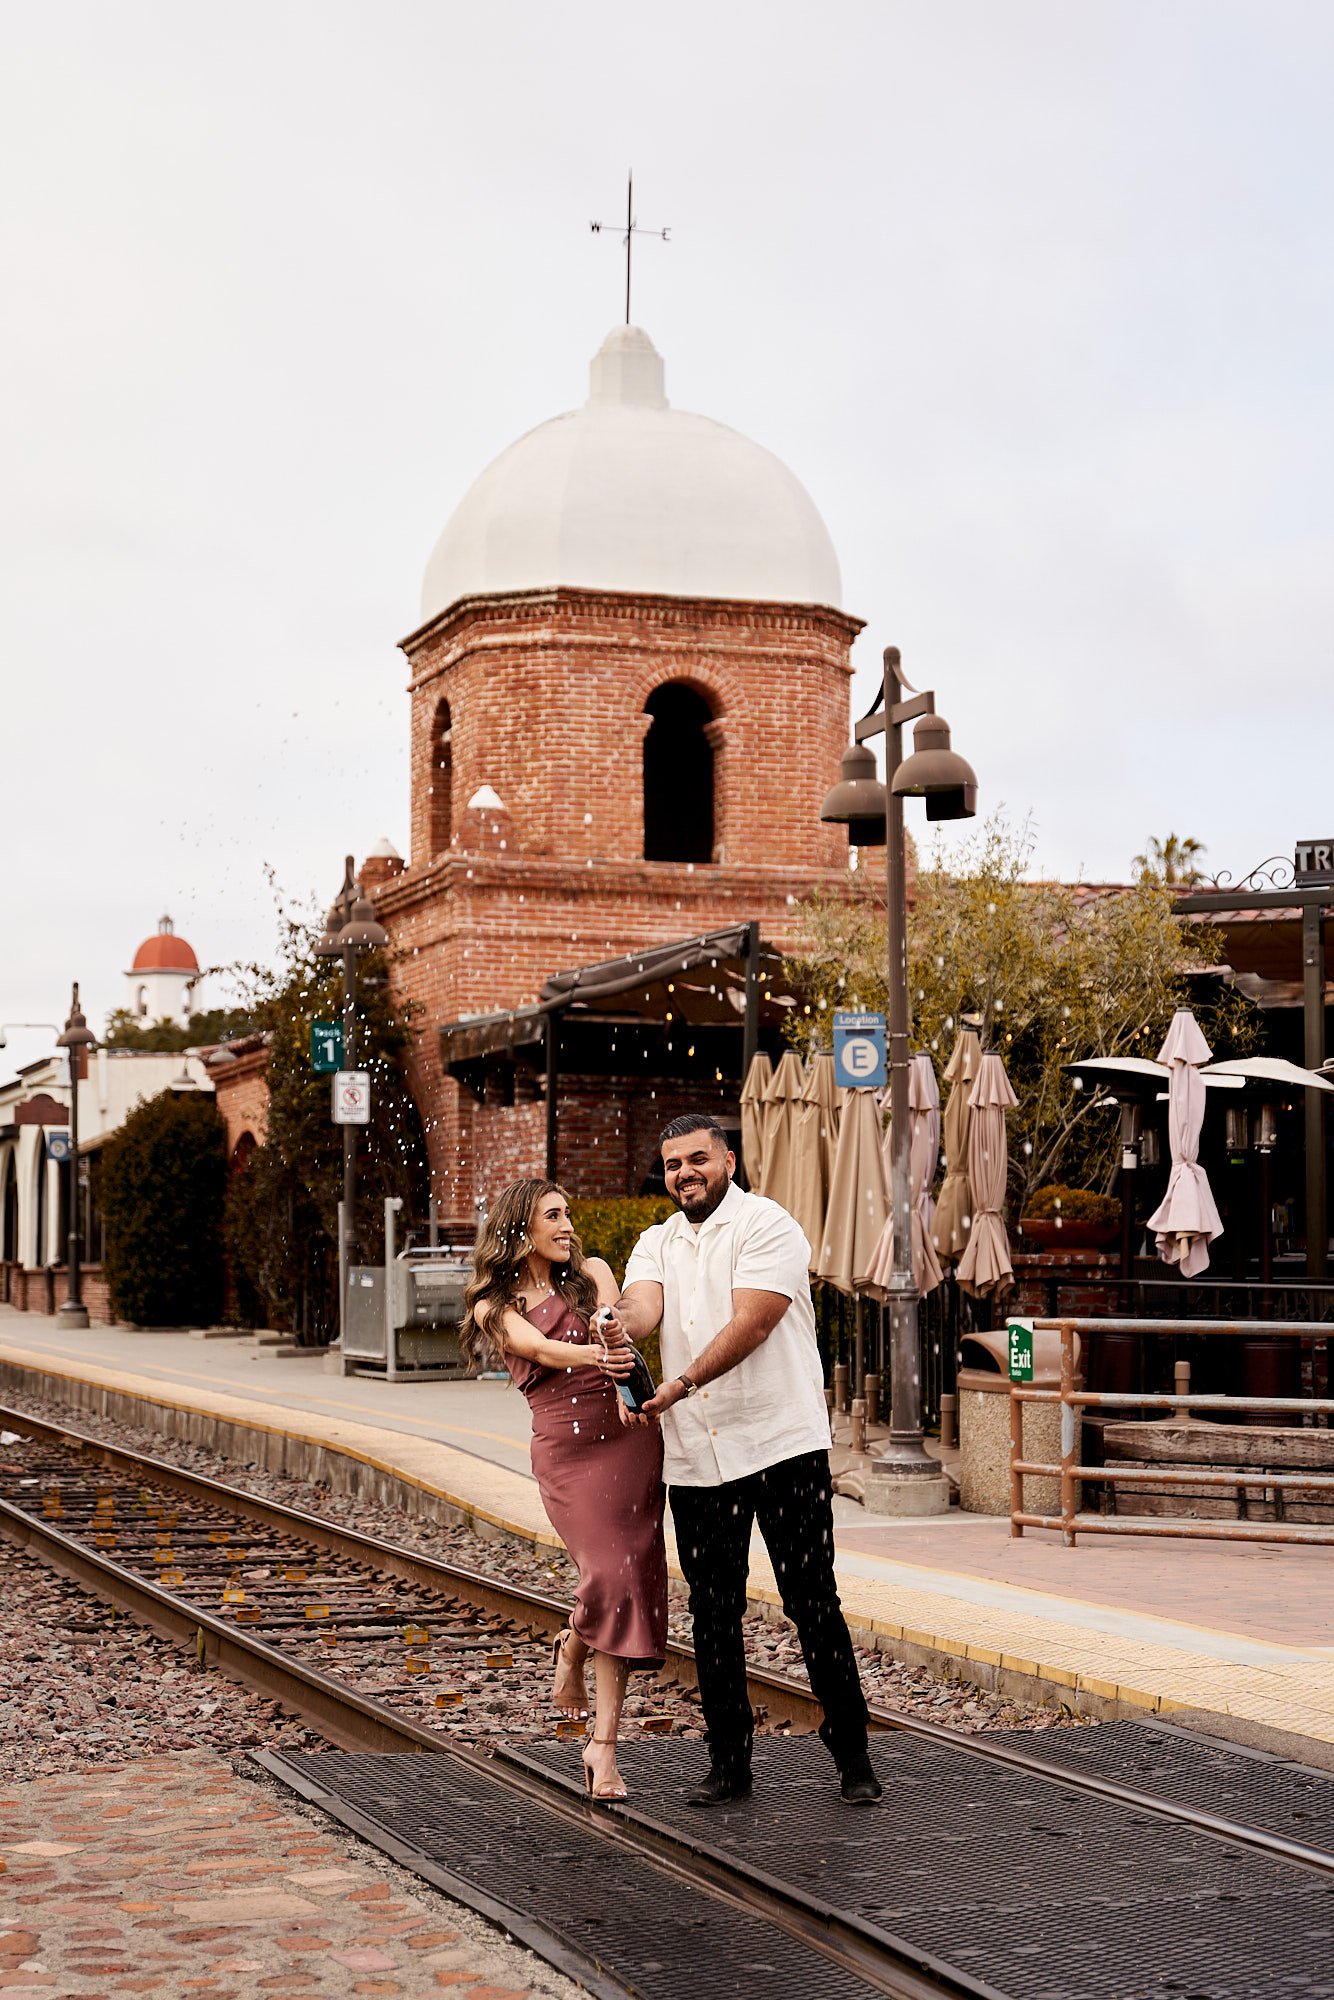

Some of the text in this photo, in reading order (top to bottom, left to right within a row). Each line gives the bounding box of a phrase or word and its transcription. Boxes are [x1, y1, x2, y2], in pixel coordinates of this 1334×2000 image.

[1295, 845, 1334, 872] TR
[840, 1015, 879, 1024] Location
[322, 1039, 334, 1062] 1
[852, 1046, 868, 1069] E
[1011, 1347, 1031, 1368] Exit
